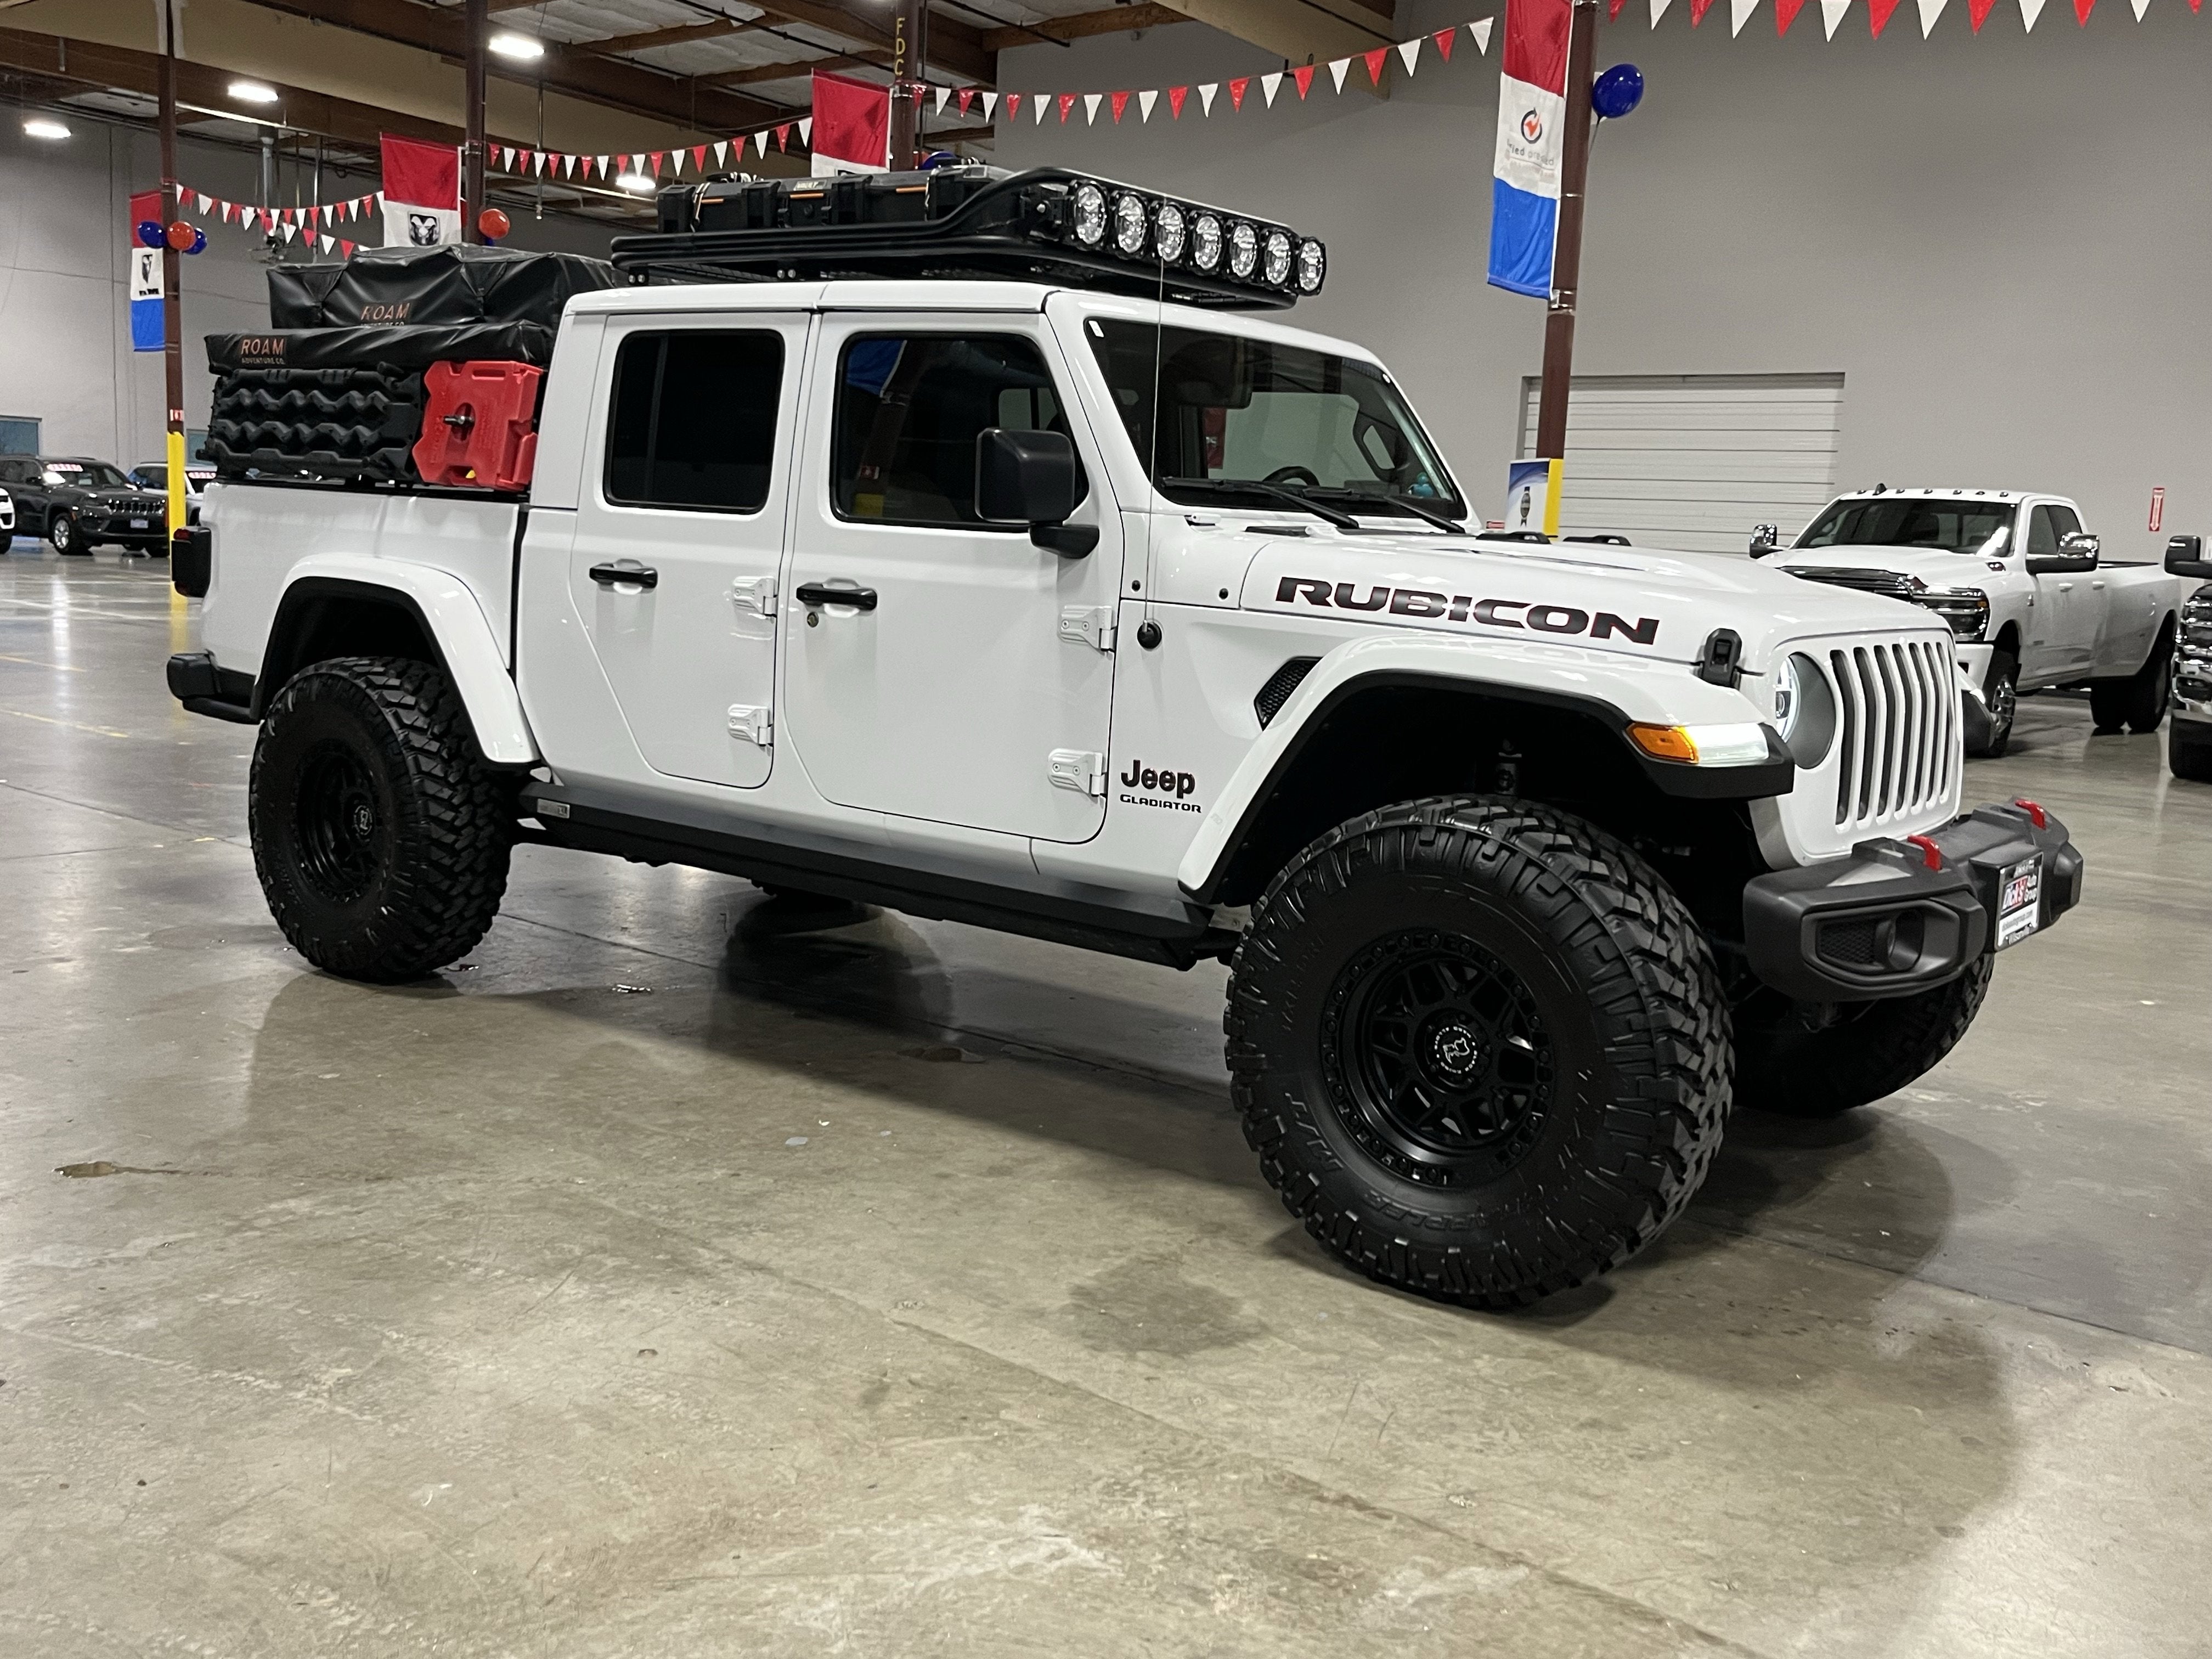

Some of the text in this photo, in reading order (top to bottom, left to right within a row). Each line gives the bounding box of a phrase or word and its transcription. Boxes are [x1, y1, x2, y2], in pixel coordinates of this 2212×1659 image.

[894, 17, 906, 76] FDC
[361, 302, 410, 320] ROAM
[241, 338, 284, 356] ROAM
[1275, 576, 1660, 645] RUBICON
[1121, 759, 1195, 799] Jeep
[1120, 794, 1201, 813] GLADIATOR
